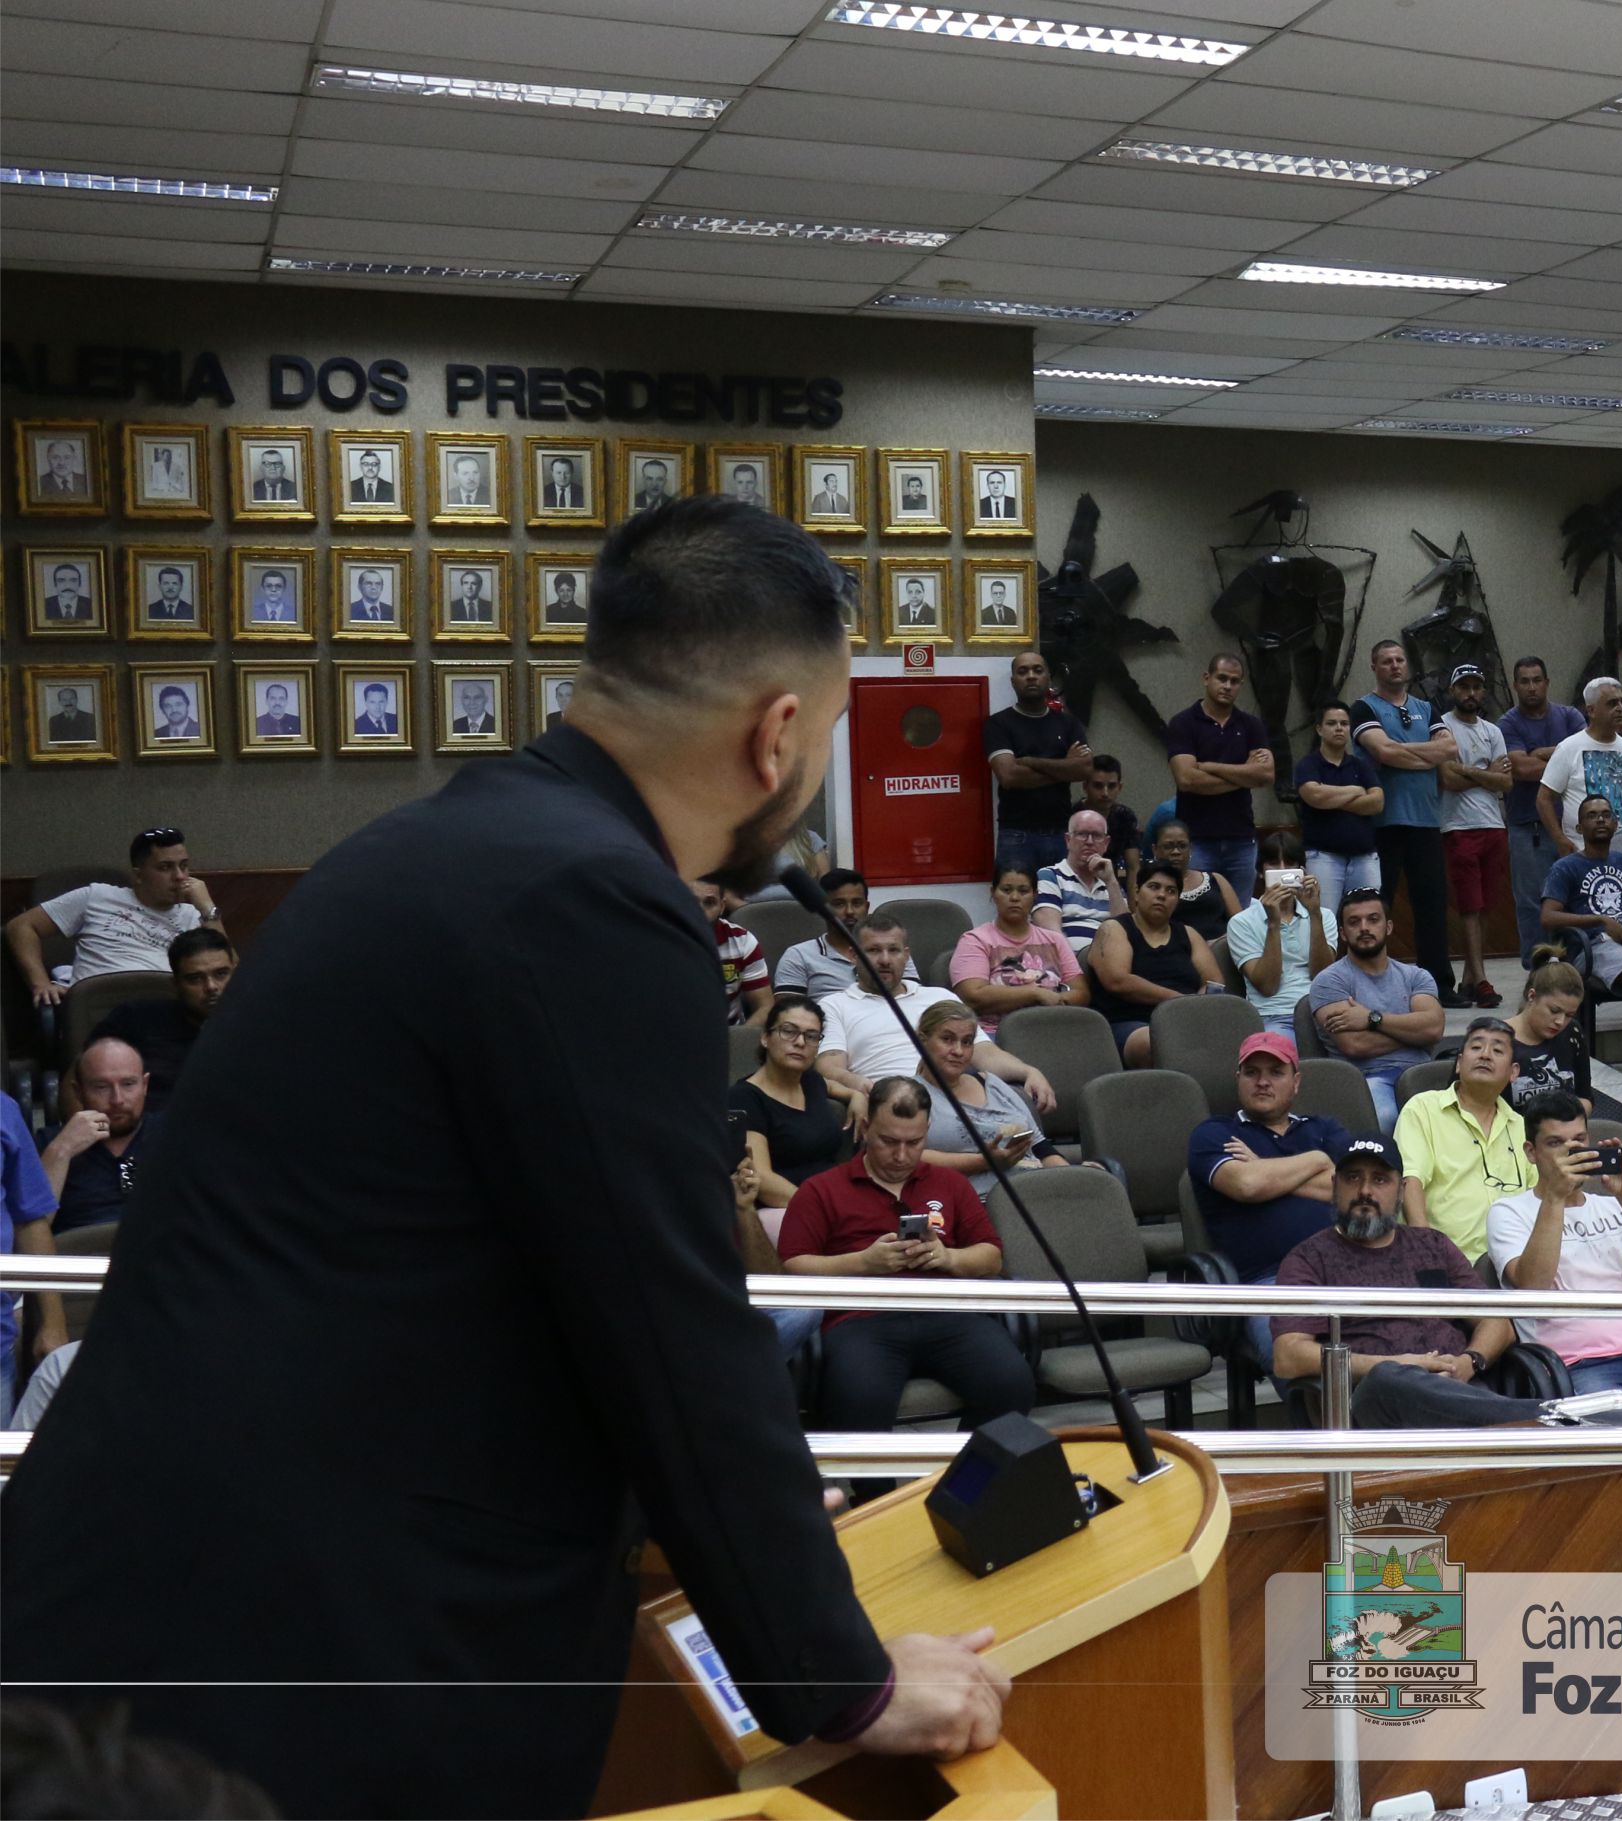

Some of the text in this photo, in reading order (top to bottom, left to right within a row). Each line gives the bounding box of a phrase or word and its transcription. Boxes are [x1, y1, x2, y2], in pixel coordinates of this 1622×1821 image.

[269, 353, 409, 414] DOS
[446, 363, 844, 430] PRESIDENTES
[887, 776, 959, 792] HIDRANTE
[1580, 867, 1602, 895] JOHN
[1348, 1139, 1384, 1153] Jeep
